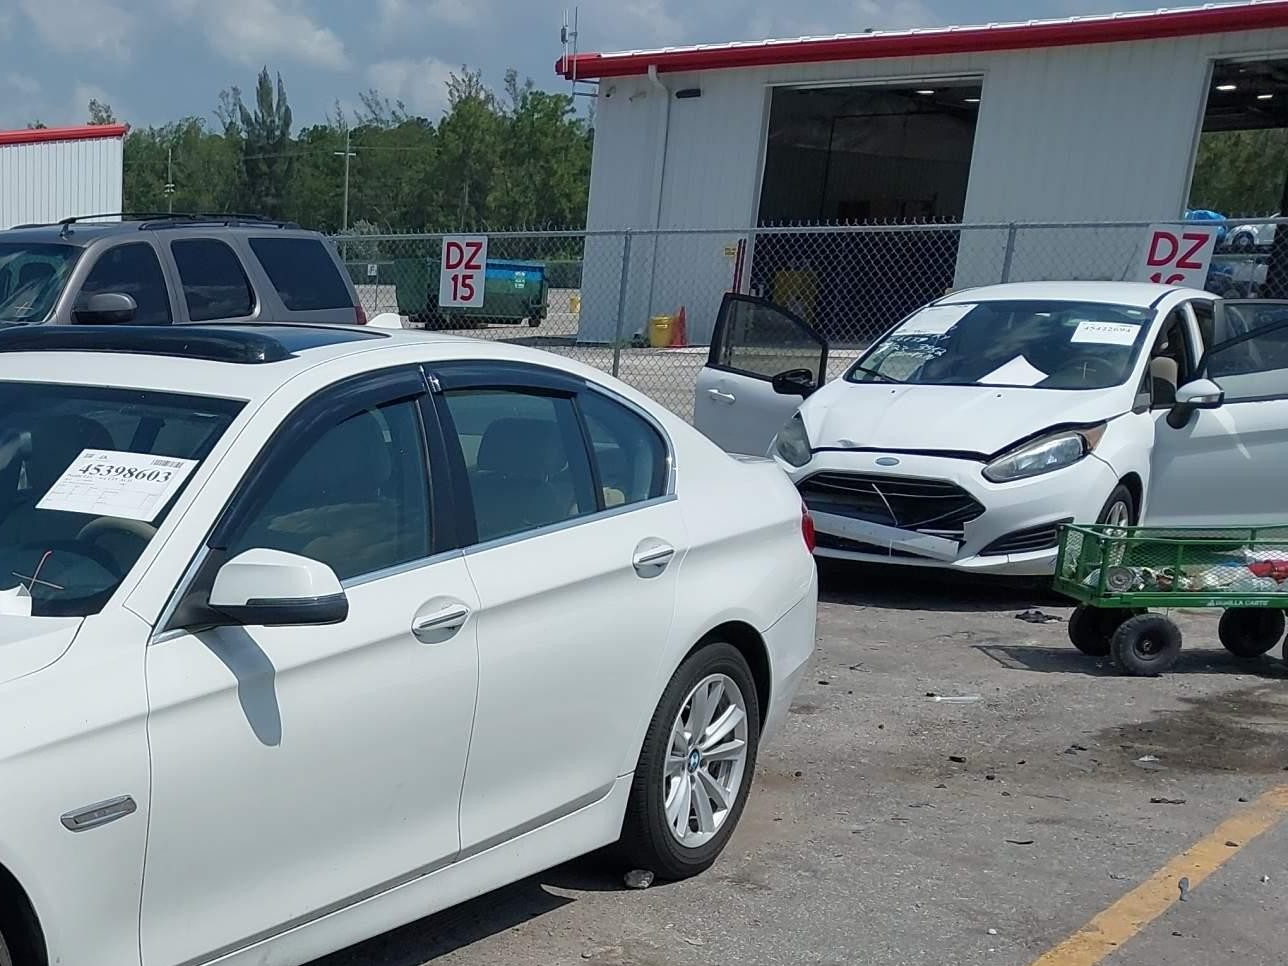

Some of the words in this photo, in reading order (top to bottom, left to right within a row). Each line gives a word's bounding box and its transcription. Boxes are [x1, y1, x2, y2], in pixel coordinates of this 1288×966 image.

[445, 241, 483, 270] DZ
[1146, 231, 1210, 270] DZ
[451, 273, 475, 302] 15
[78, 463, 172, 483] 45398603
